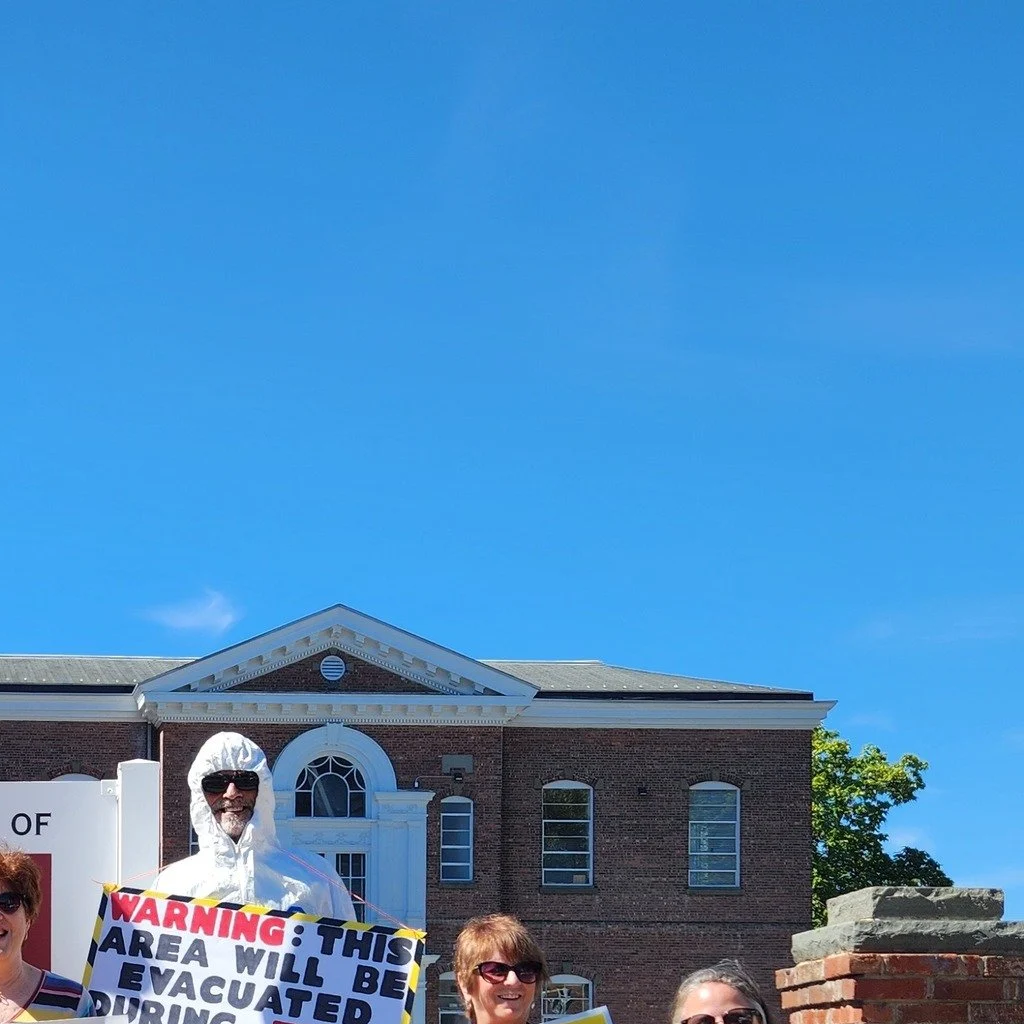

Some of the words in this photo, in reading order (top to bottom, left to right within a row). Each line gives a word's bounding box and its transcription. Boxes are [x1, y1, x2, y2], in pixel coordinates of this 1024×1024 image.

[11, 812, 51, 836] OF
[98, 926, 209, 968] AREA
[235, 945, 324, 988] WILL
[352, 965, 408, 1000] BE
[316, 924, 413, 965] THIS
